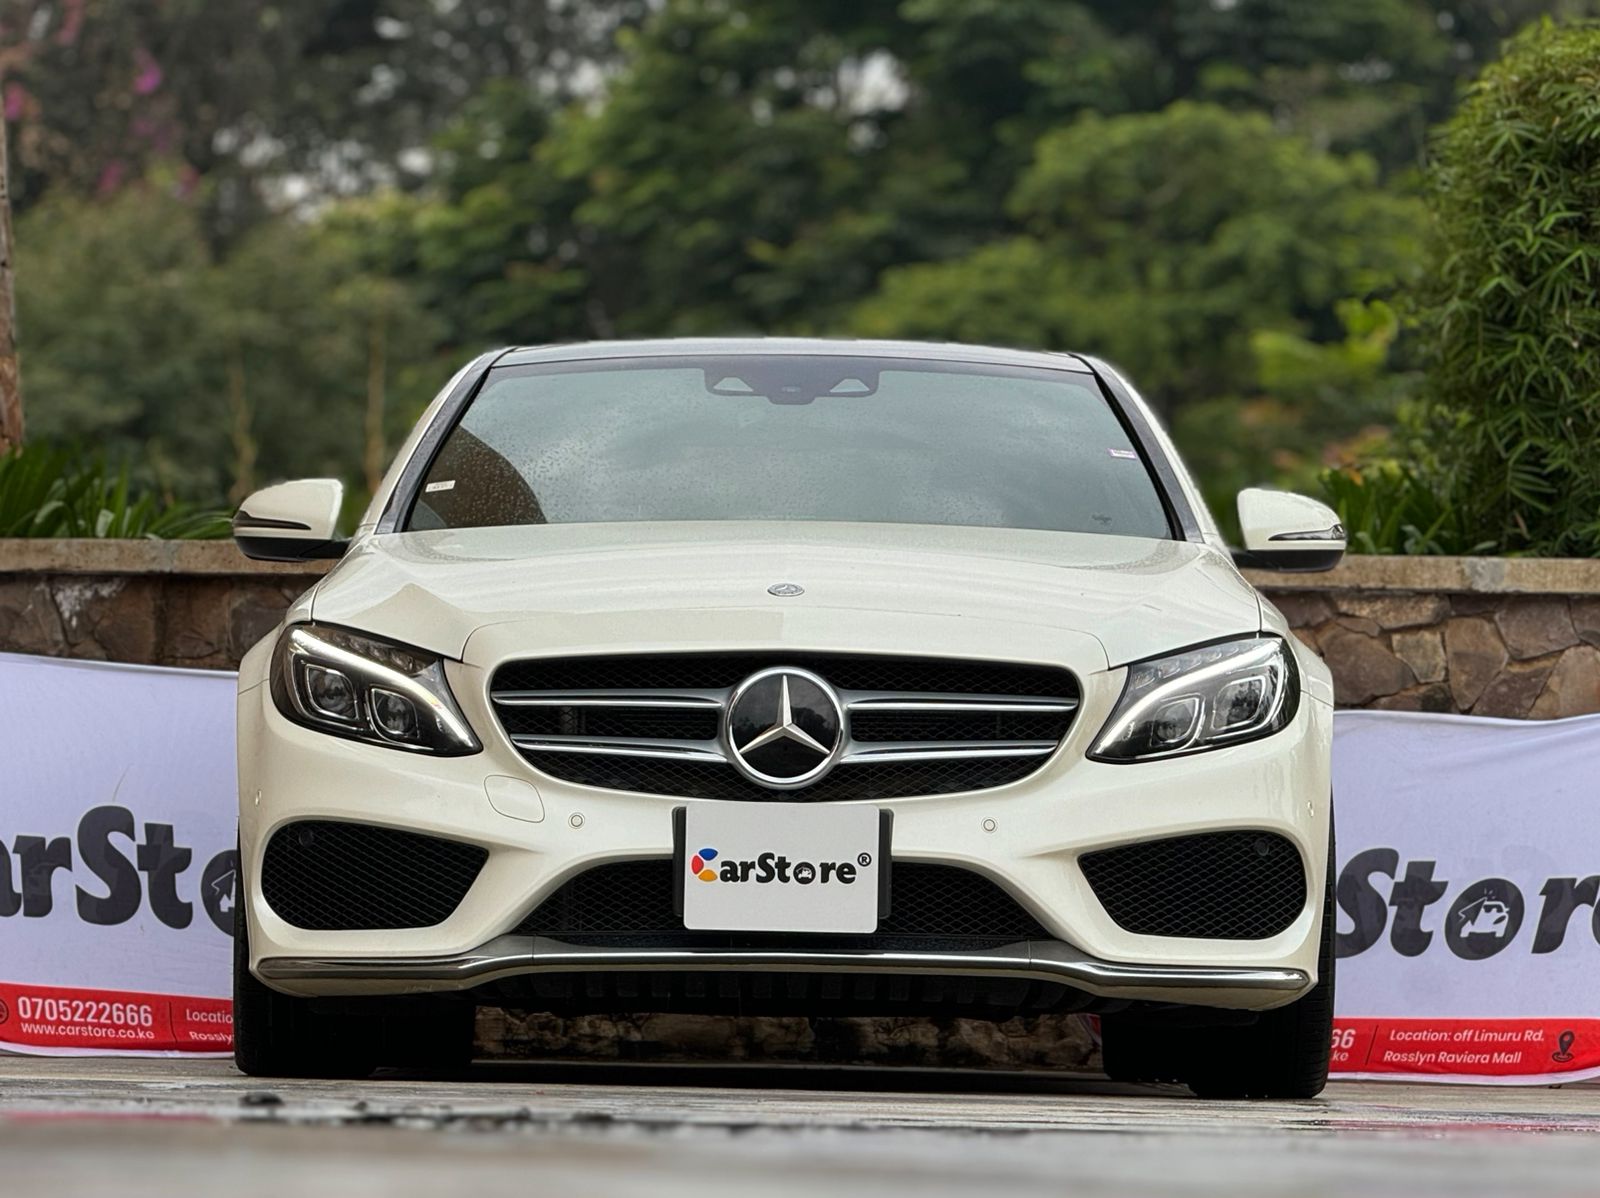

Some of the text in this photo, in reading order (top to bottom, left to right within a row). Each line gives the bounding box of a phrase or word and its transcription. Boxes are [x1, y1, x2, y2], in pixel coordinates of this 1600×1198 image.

[1336, 847, 1600, 961] Stor
[17, 996, 153, 1027] 0705222666
[188, 1031, 235, 1046] Rossly
[1389, 1029, 1545, 1043] Location: off Limuru Rd.
[1383, 1050, 1522, 1067] Rosslyn Raviera Mall
